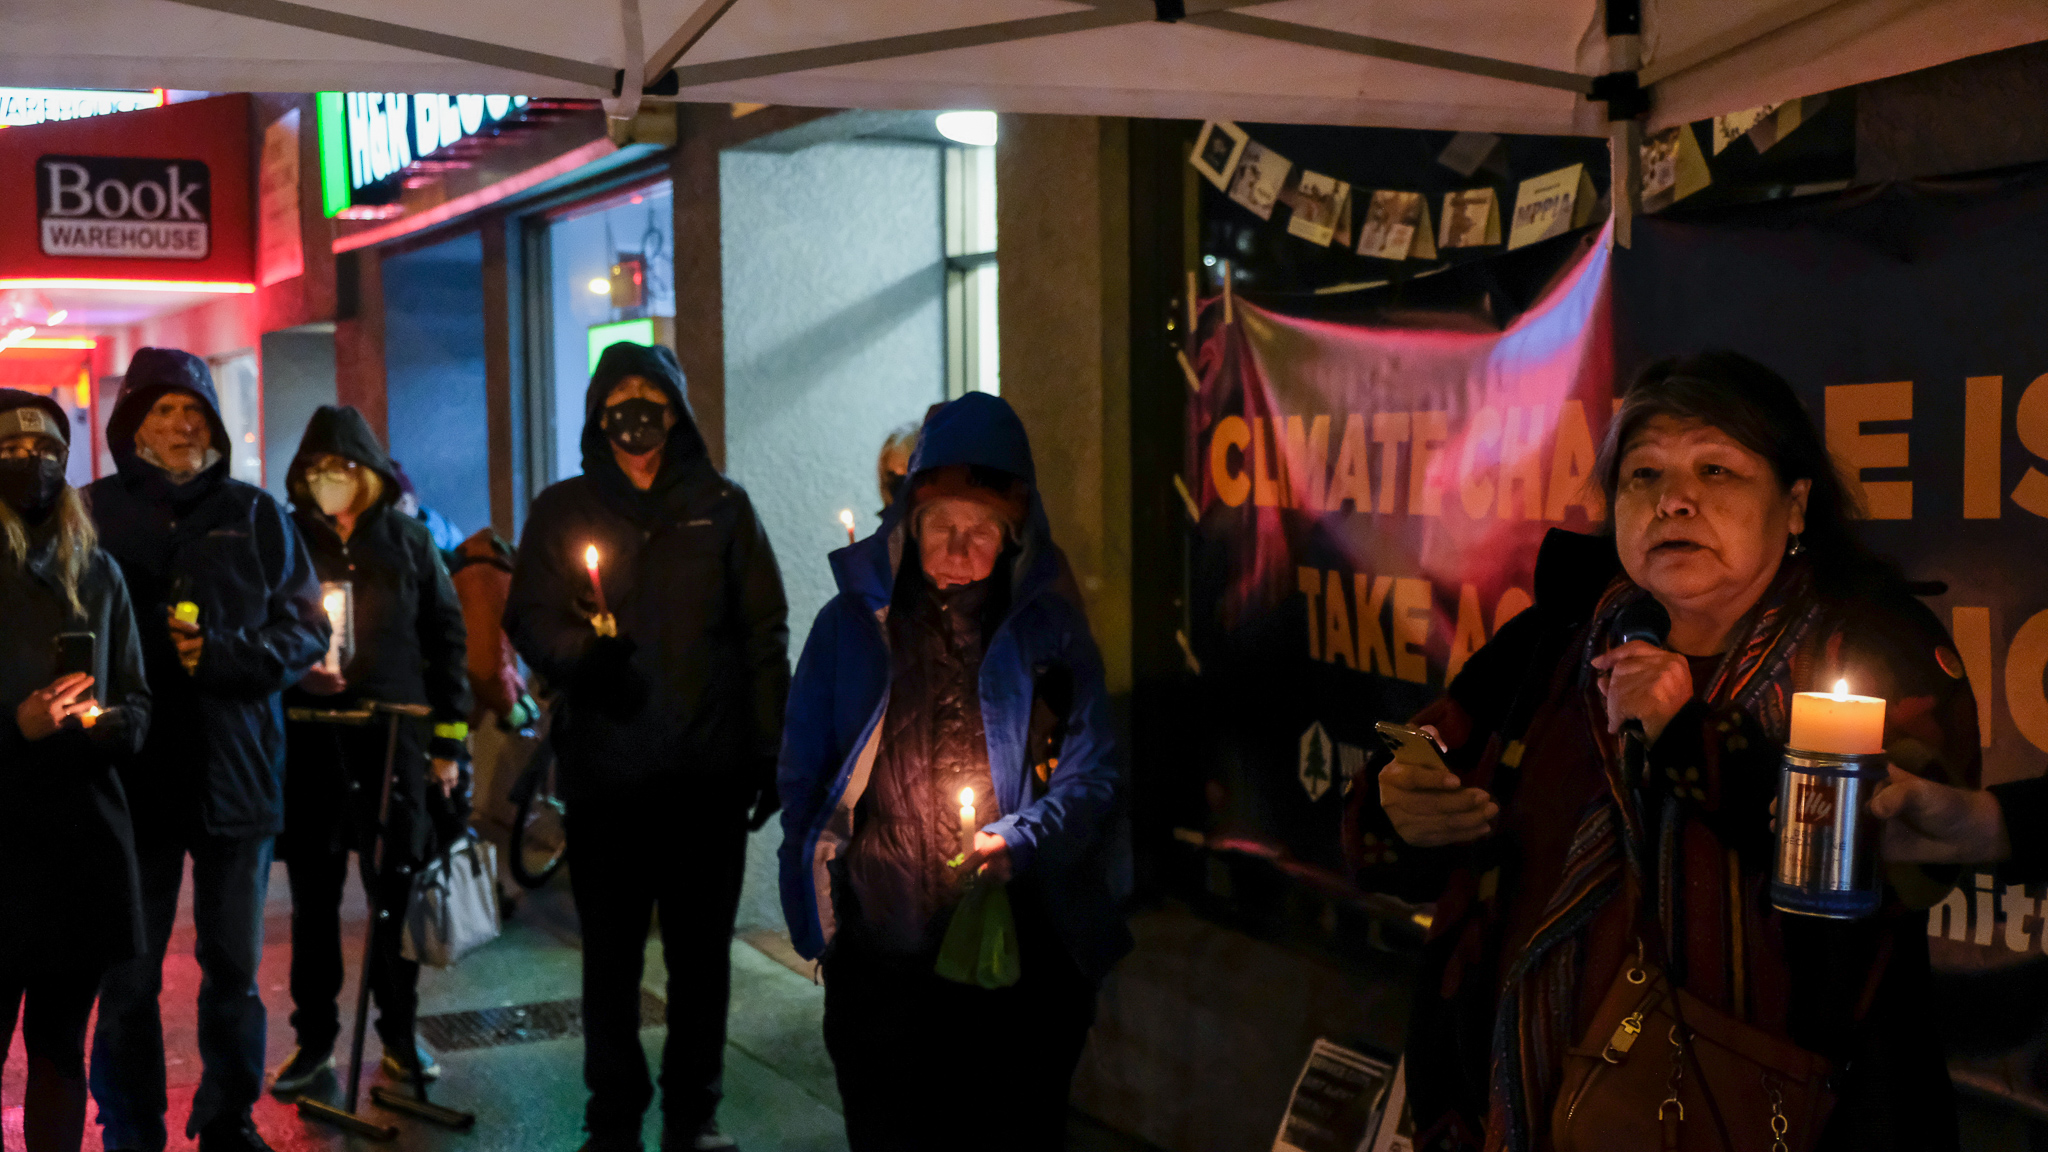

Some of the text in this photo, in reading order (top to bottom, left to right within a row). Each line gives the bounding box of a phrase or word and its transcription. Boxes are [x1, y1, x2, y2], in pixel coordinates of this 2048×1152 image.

[44, 162, 203, 220] Book
[50, 225, 201, 250] WAREHOUSE
[1211, 410, 1449, 517] CLIMATE
[1297, 566, 1433, 684] TAKE
